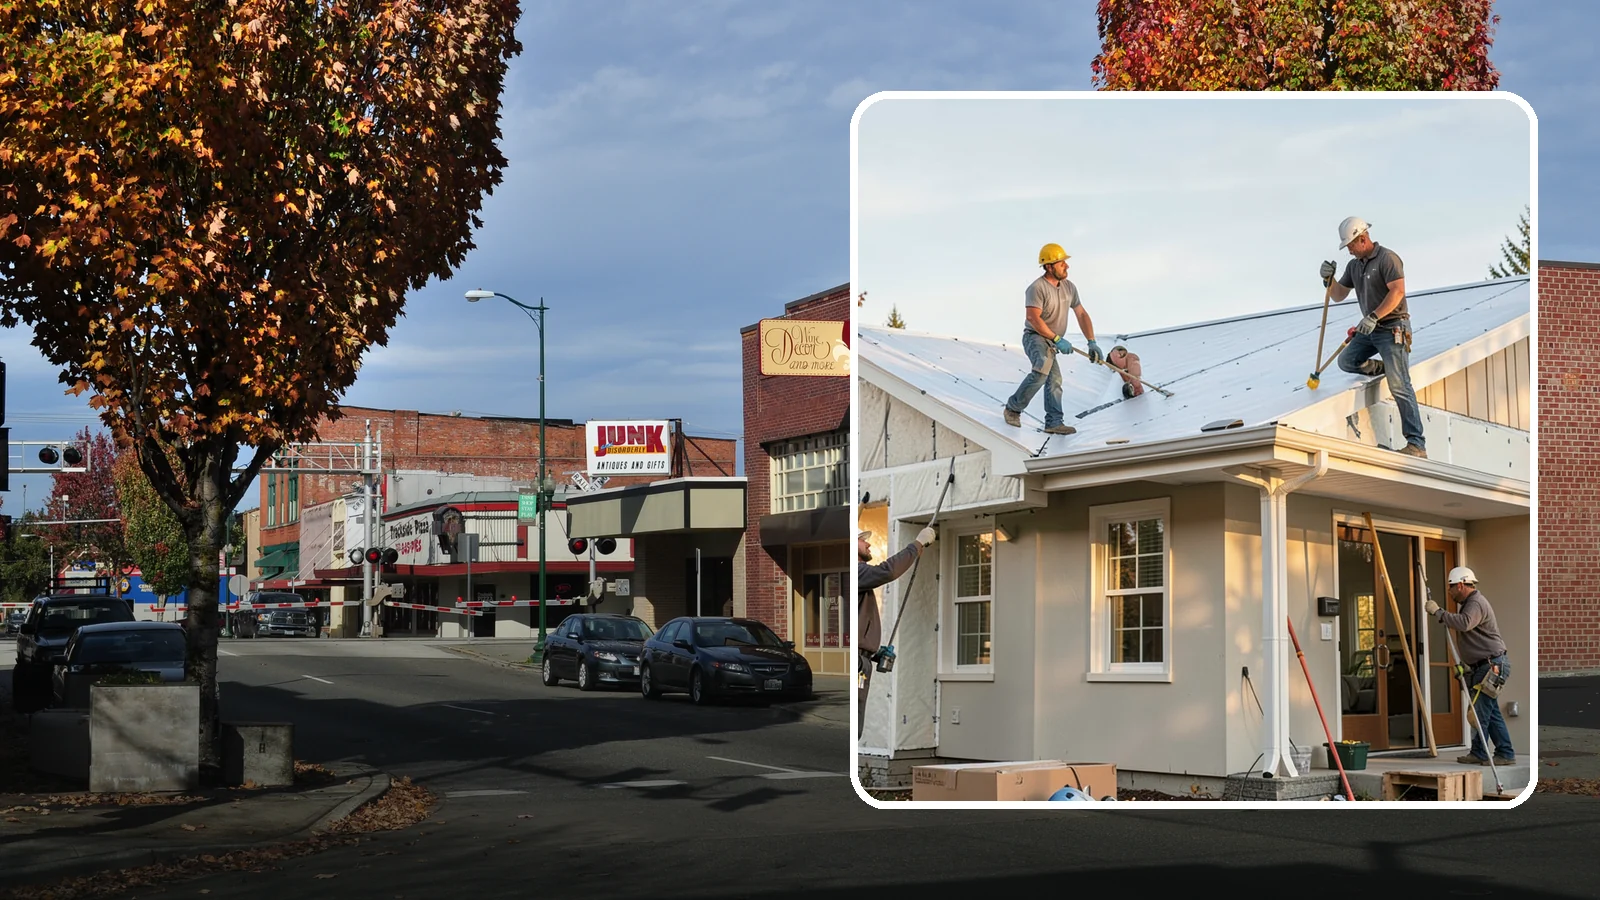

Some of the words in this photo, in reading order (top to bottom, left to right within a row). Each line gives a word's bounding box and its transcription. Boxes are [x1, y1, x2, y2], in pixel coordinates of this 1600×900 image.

[595, 425, 665, 457] JUNK
[607, 446, 646, 454] DISORDERLY
[597, 461, 628, 470] ANTIQUES
[631, 461, 644, 470] AND
[647, 460, 665, 469] GIFTS
[352, 498, 364, 511] CRO
[414, 519, 429, 535] Pizza
